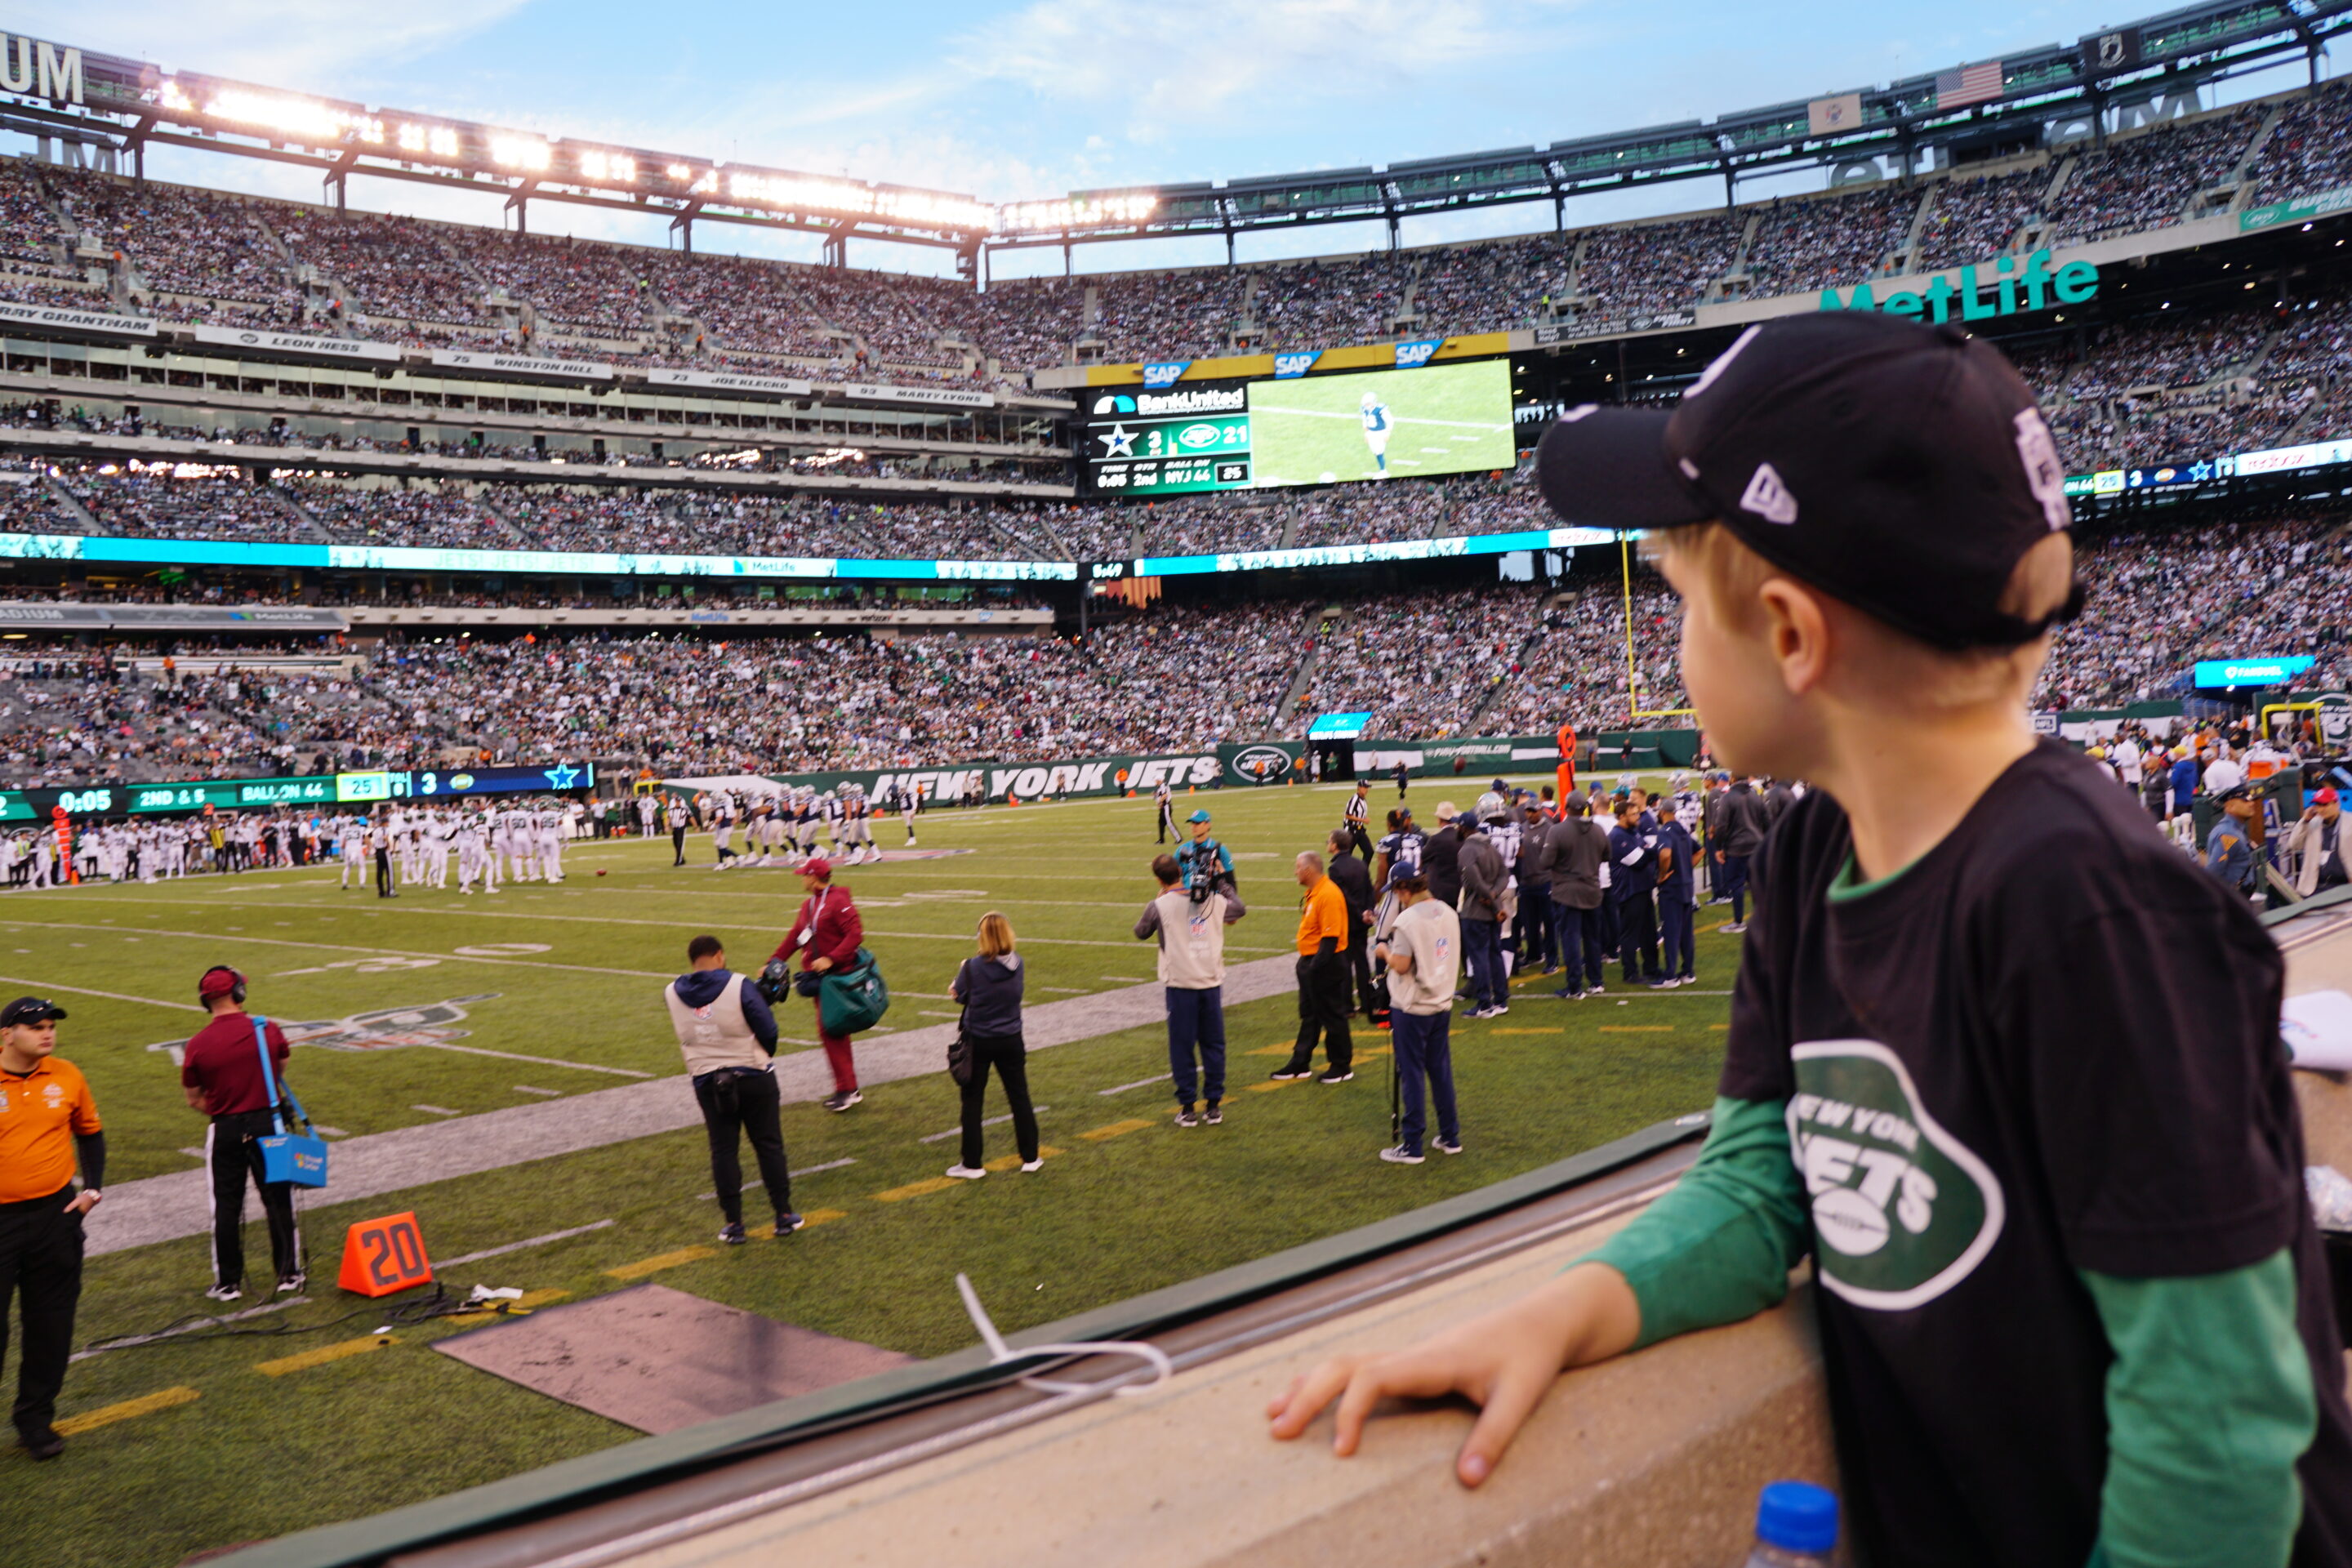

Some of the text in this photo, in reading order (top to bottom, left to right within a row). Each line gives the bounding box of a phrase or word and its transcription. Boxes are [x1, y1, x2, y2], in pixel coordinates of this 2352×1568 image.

[0, 33, 84, 105] UM
[42, 310, 149, 331] GRANTHAM
[272, 336, 361, 353] LEON HESS
[1396, 344, 1433, 364] SAP
[452, 354, 594, 374] 75 WINSTON HILL
[1275, 355, 1312, 375] SAP
[671, 373, 790, 390] 73 JOE KLECKO
[1144, 365, 1182, 385] SAP
[1137, 388, 1244, 411] BankUnited
[1147, 430, 1162, 448] 3
[1223, 425, 1248, 444] 21
[1133, 472, 1158, 487] 2nd
[1192, 468, 1212, 483] 44
[434, 550, 595, 571] JETS! JETS! JETS!
[752, 561, 795, 572] MetLife
[691, 612, 729, 622] MetLife
[352, 779, 372, 794] 25
[421, 772, 438, 795] 3
[870, 756, 1222, 805] NEW YORK JETS
[59, 790, 112, 813] 0:05
[140, 788, 205, 807] 2ND & 5
[243, 785, 278, 801] BALL
[304, 782, 324, 797] 44
[1797, 1093, 1855, 1130] EW
[1801, 1133, 1939, 1235] ETS
[361, 1221, 425, 1287] 20
